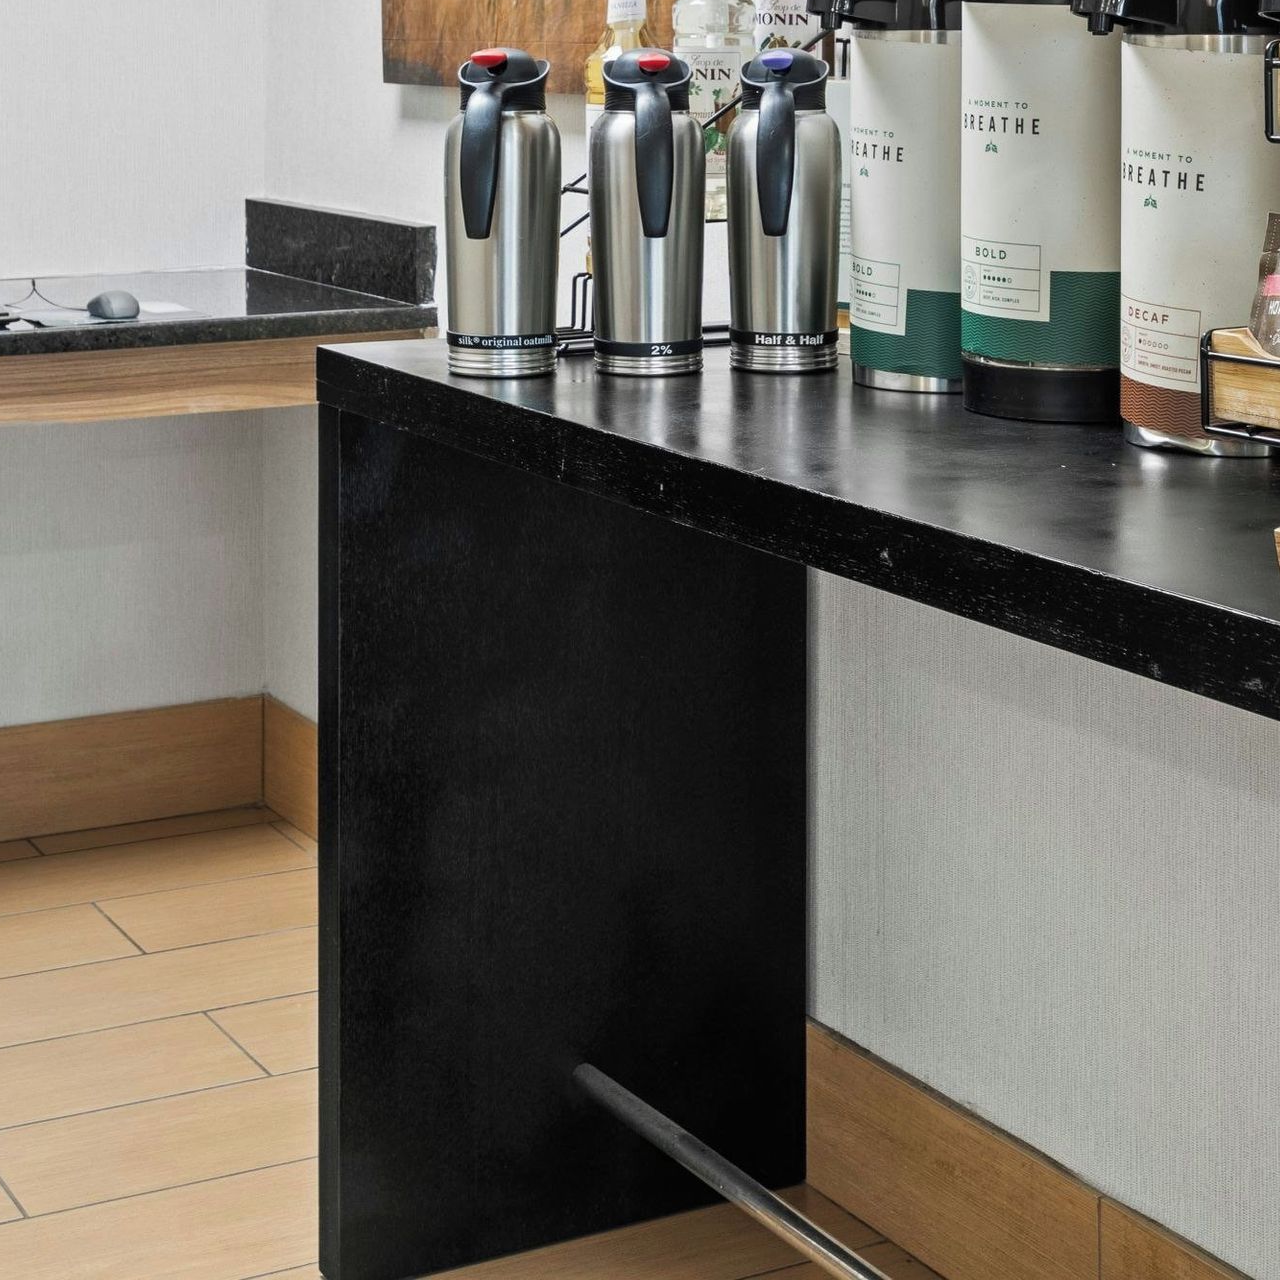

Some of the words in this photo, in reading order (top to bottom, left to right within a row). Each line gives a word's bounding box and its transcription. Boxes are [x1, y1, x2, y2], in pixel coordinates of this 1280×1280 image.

[755, 13, 809, 26] MONIN
[692, 68, 731, 80] NIN
[974, 100, 1009, 108] MOMENT
[1014, 102, 1028, 110] TO
[964, 113, 1040, 135] BREATHE
[851, 139, 904, 162] REATHE
[1133, 150, 1171, 161] MOMENT
[1178, 155, 1193, 164] TO
[1123, 162, 1205, 191] BREATHE
[976, 246, 1007, 260] BOLD
[852, 261, 873, 276] BOLD
[1128, 306, 1169, 325] DECAF
[482, 336, 522, 348] original
[755, 334, 783, 345] Half
[785, 335, 796, 345] &
[800, 334, 824, 345] Half
[651, 345, 672, 356] 2%
